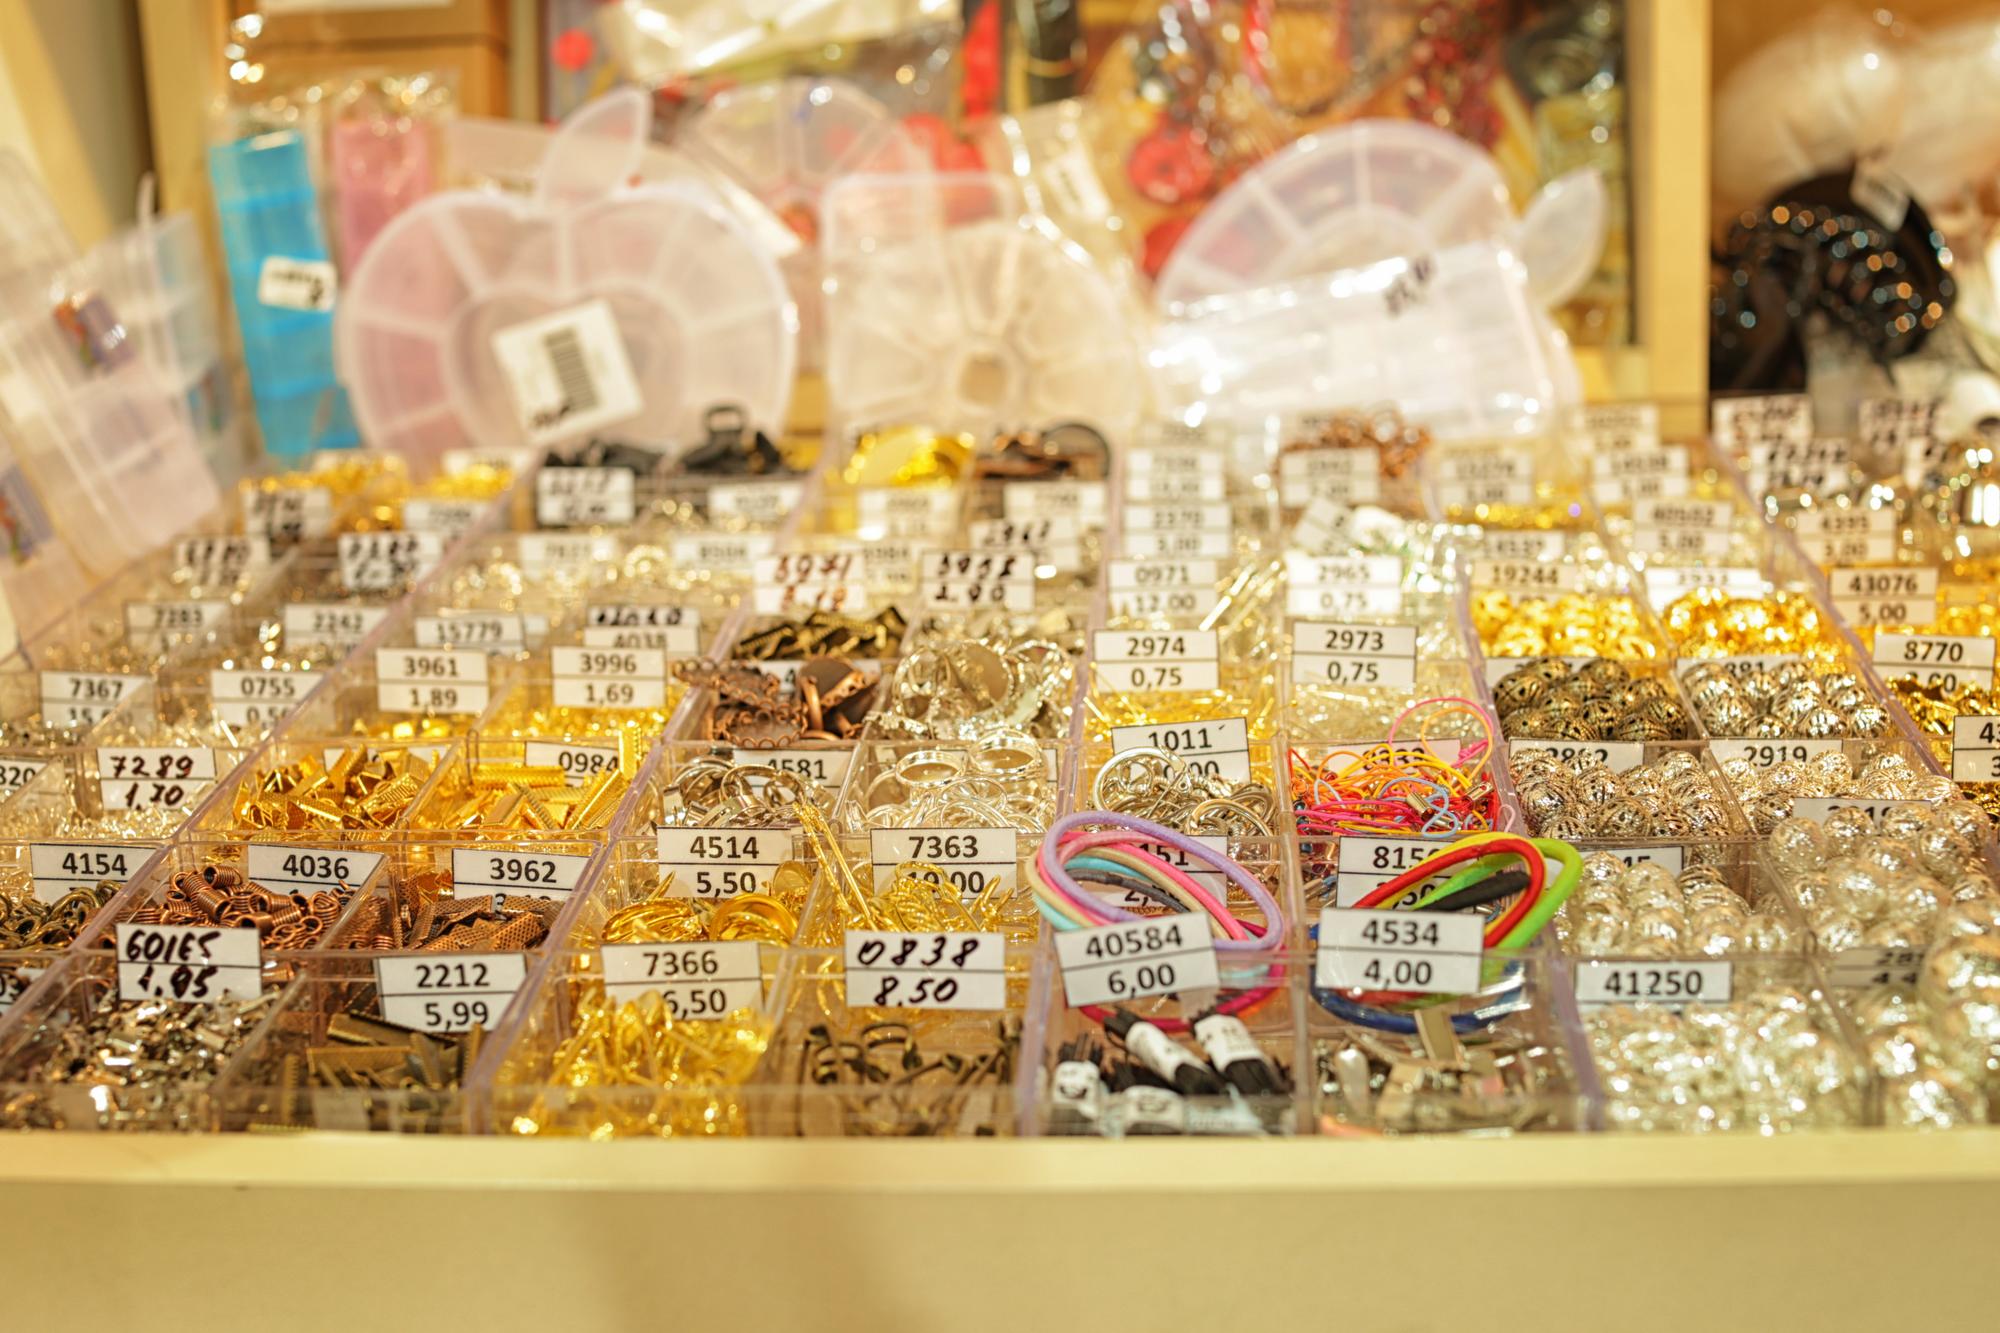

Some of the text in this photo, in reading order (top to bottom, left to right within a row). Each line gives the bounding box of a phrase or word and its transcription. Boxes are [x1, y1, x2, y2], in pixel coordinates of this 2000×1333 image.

[1492, 565, 1559, 584] 19244
[1849, 573, 1918, 593] 43076
[1857, 603, 1908, 626] 5,00
[437, 620, 503, 642] 15779
[1325, 629, 1385, 651] 2973
[1126, 636, 1187, 657] 2974
[1904, 640, 1964, 662] 8770
[404, 655, 460, 677] 3961
[579, 653, 637, 674] 3996
[1327, 660, 1380, 685] 0,75
[69, 677, 124, 700] 7367
[240, 678, 296, 699] 0755
[1130, 667, 1183, 690] 0,75
[410, 688, 458, 711] 1,89
[585, 684, 634, 706] 1,69
[1148, 727, 1213, 752] 1011
[110, 754, 194, 779] 7289
[558, 751, 619, 774] 0984
[1742, 746, 1808, 768] 2919
[689, 834, 760, 860] 4514
[908, 836, 980, 859] 7363
[62, 852, 128, 877] 4154
[281, 854, 350, 881] 4036
[489, 857, 558, 884] 3962
[695, 871, 757, 898] 5,50
[1085, 923, 1184, 959] 40584
[1360, 917, 1441, 947] 4534
[642, 949, 719, 978] 7366
[857, 935, 980, 968] 0838
[414, 963, 490, 990] 2212
[1106, 962, 1177, 998] 6,00
[1362, 958, 1434, 990] 4,00
[1603, 968, 1706, 997] 41250
[663, 988, 726, 1020] 6,50
[873, 976, 960, 1009] 8.50
[424, 1000, 489, 1030] 5,99
